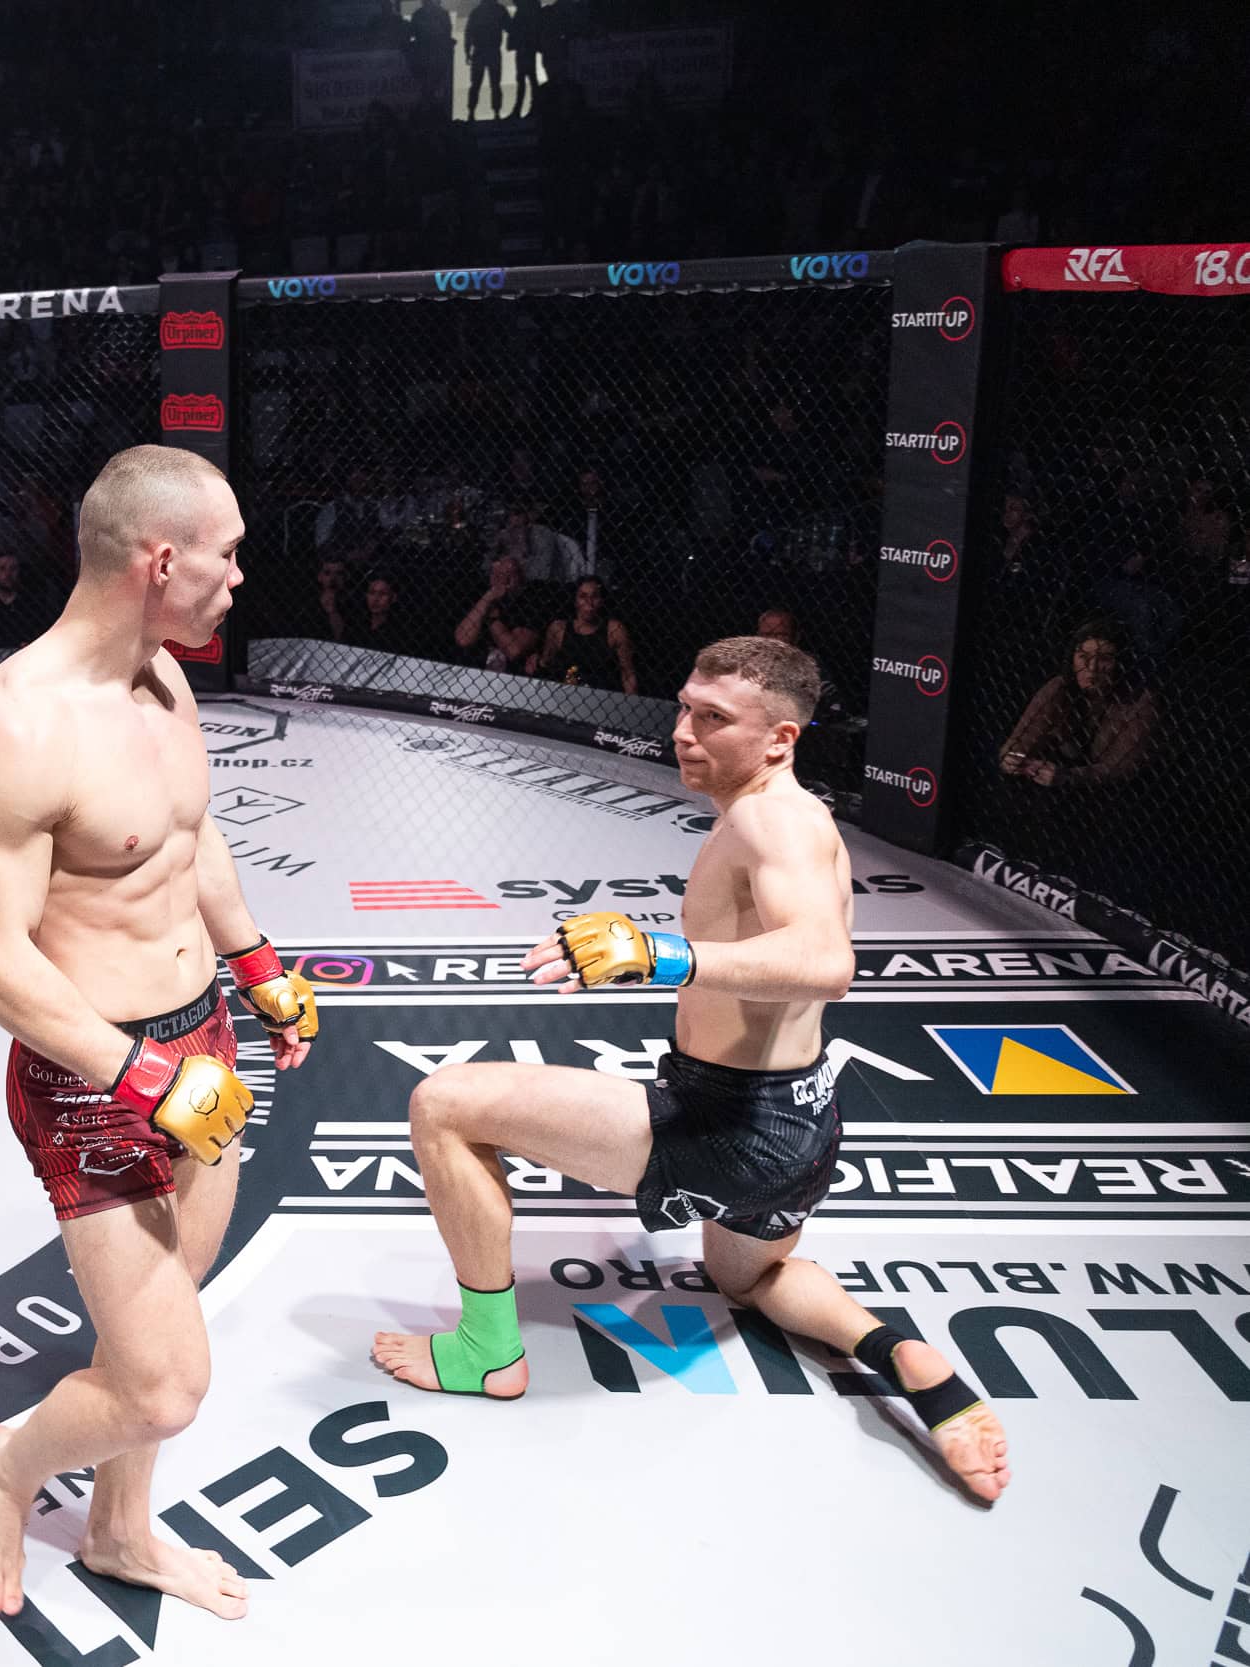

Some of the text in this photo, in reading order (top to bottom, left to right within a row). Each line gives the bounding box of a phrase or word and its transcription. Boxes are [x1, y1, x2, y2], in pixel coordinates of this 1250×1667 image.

[607, 262, 680, 286] VOYO
[790, 253, 869, 280] VOYO
[1064, 248, 1132, 283] RFA
[268, 276, 336, 298] VOYO
[435, 268, 505, 292] VOYO
[207, 758, 314, 769] hop.cz
[1004, 866, 1076, 921] VARTA
[145, 994, 212, 1041] OCTAGON
[29, 1063, 88, 1088] GOLDEN
